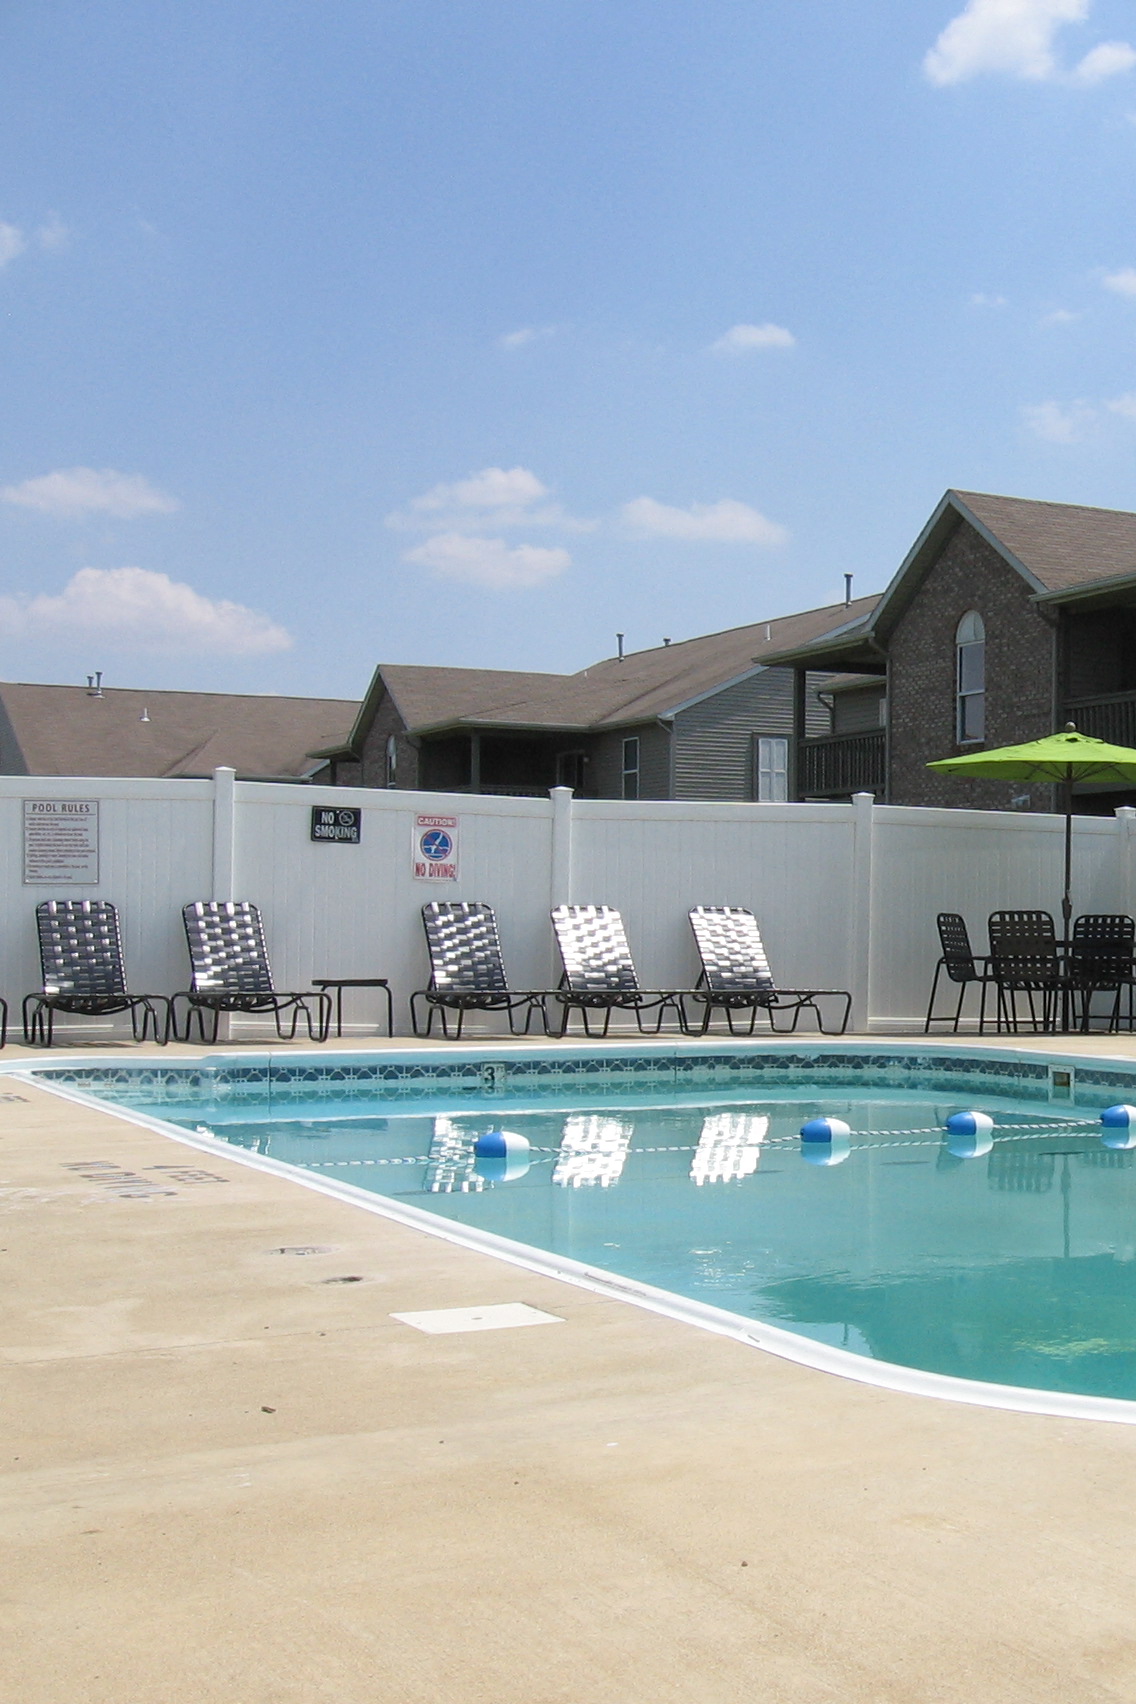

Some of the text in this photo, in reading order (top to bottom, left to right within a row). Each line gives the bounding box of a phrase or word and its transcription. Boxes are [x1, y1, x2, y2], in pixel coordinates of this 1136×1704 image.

[32, 803, 90, 813] POOL RULES
[321, 811, 335, 824] NO
[315, 824, 358, 838] SMOKING
[415, 862, 426, 877] NO
